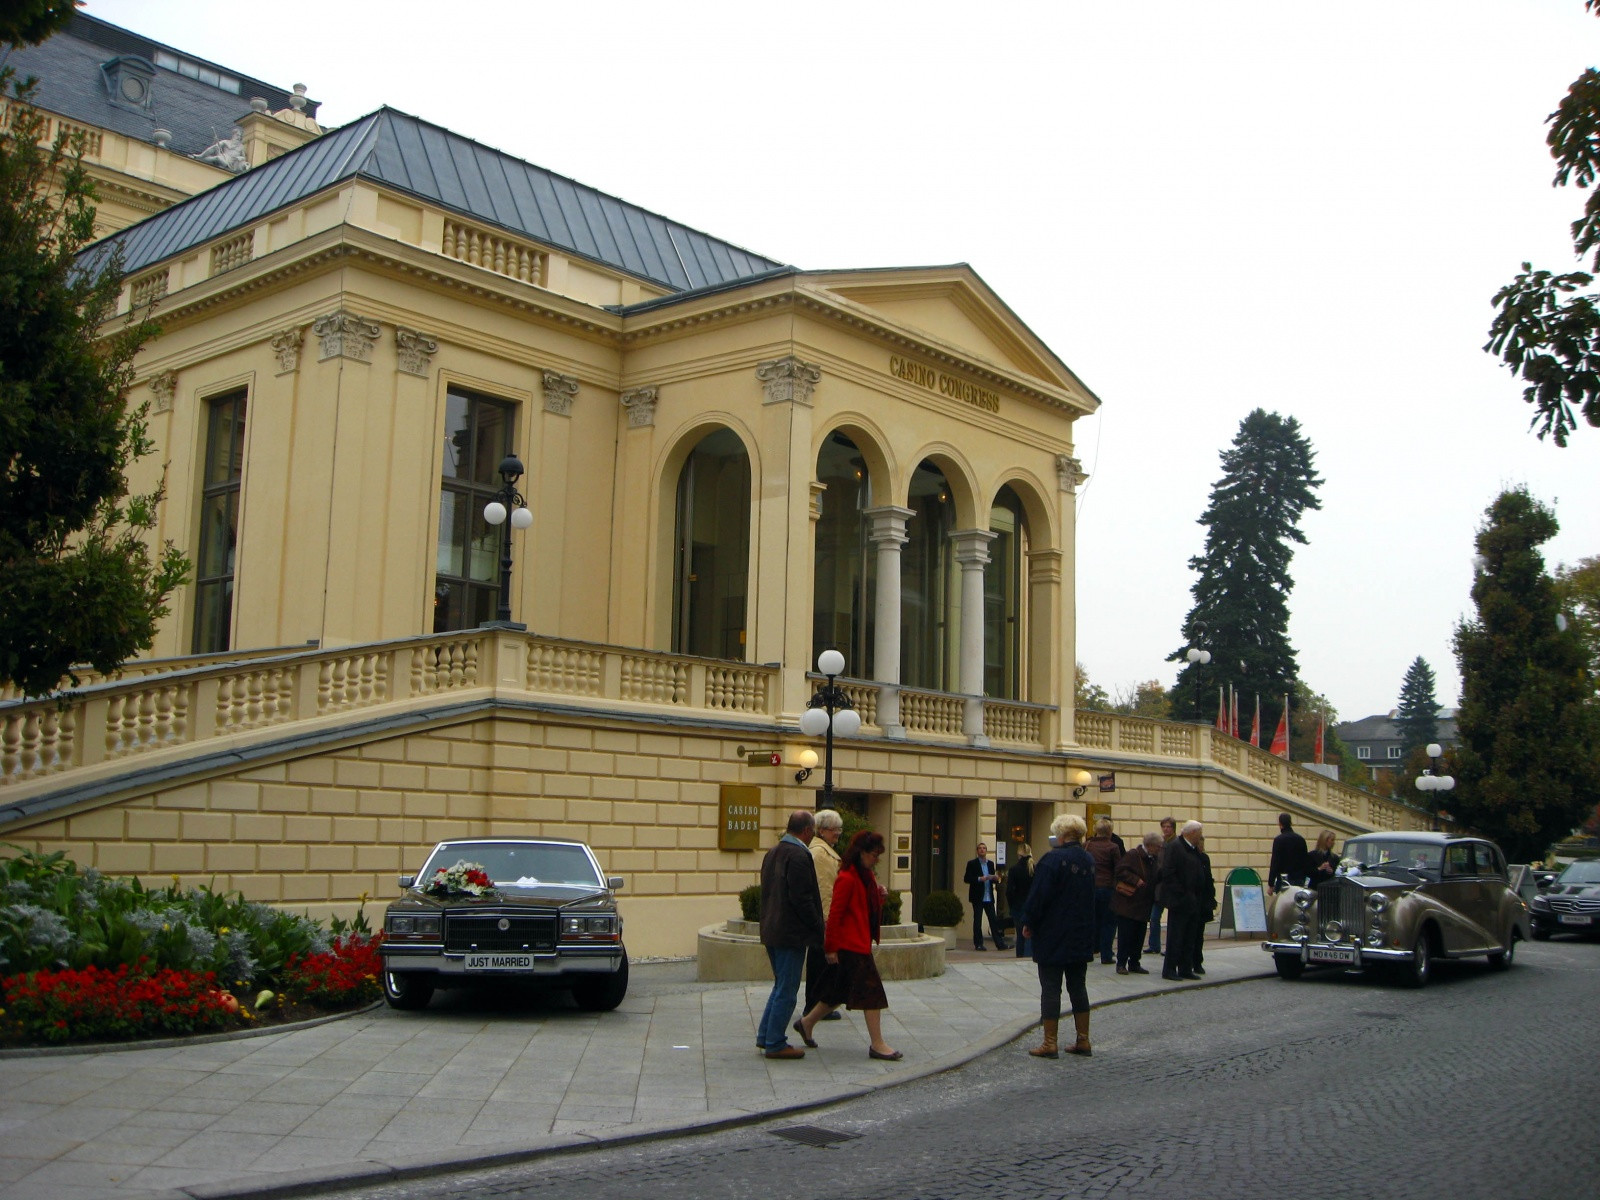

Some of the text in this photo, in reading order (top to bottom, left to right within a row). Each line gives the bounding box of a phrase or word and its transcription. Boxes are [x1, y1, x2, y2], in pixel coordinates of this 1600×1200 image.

[889, 355, 1000, 413] CASINO CONGRESS
[728, 805, 758, 815] CASINO
[728, 820, 758, 831] BADEN
[468, 957, 530, 967] JUST MARRIED
